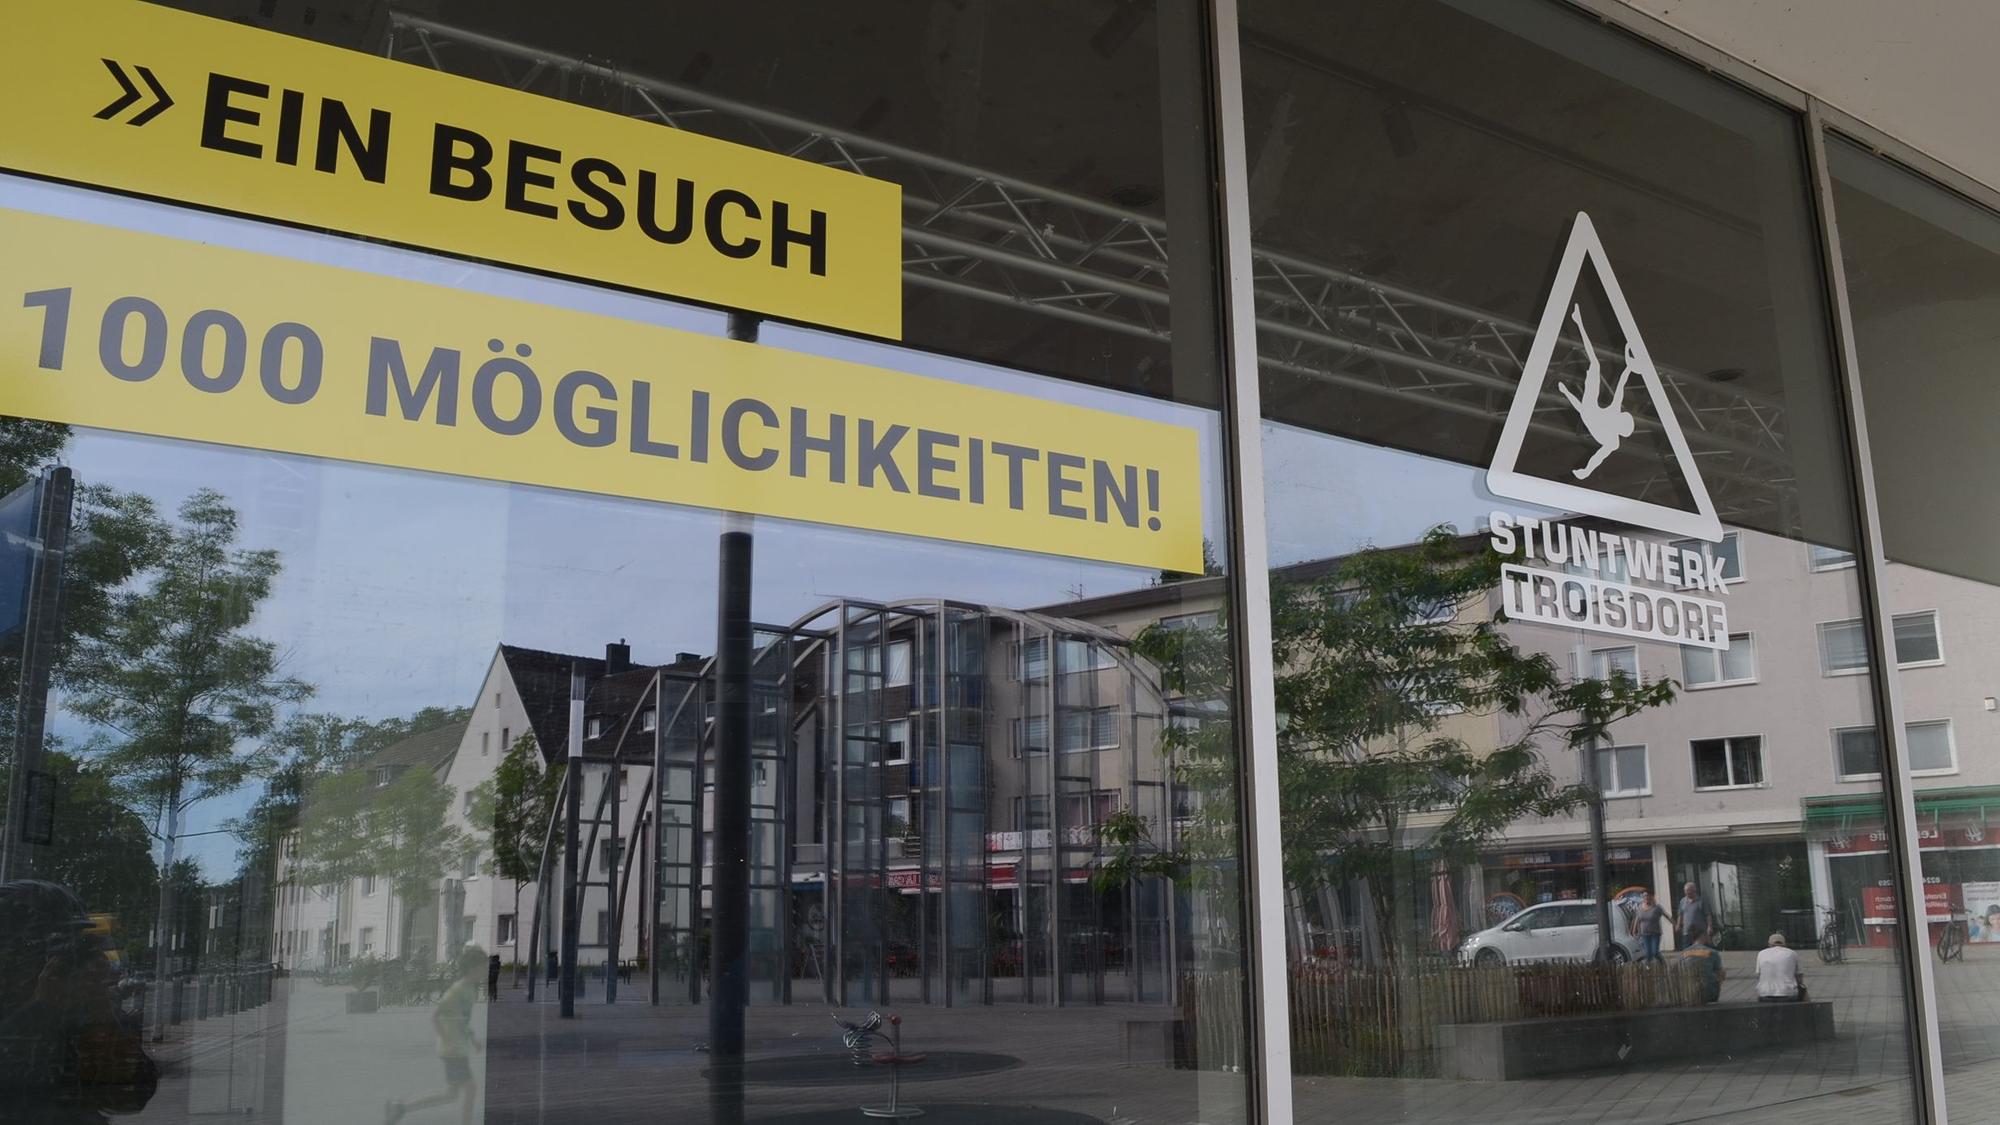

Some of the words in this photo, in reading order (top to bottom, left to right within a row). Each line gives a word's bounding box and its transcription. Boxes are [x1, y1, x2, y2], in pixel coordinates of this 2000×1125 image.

[201, 72, 392, 185] EIN
[429, 123, 828, 277] BESUCH
[23, 286, 325, 405] 1000
[364, 337, 1161, 532] MÖGLICHKEITEN!
[1489, 510, 1729, 595] STUNTWERK
[1505, 569, 1724, 643] TROISDORF
